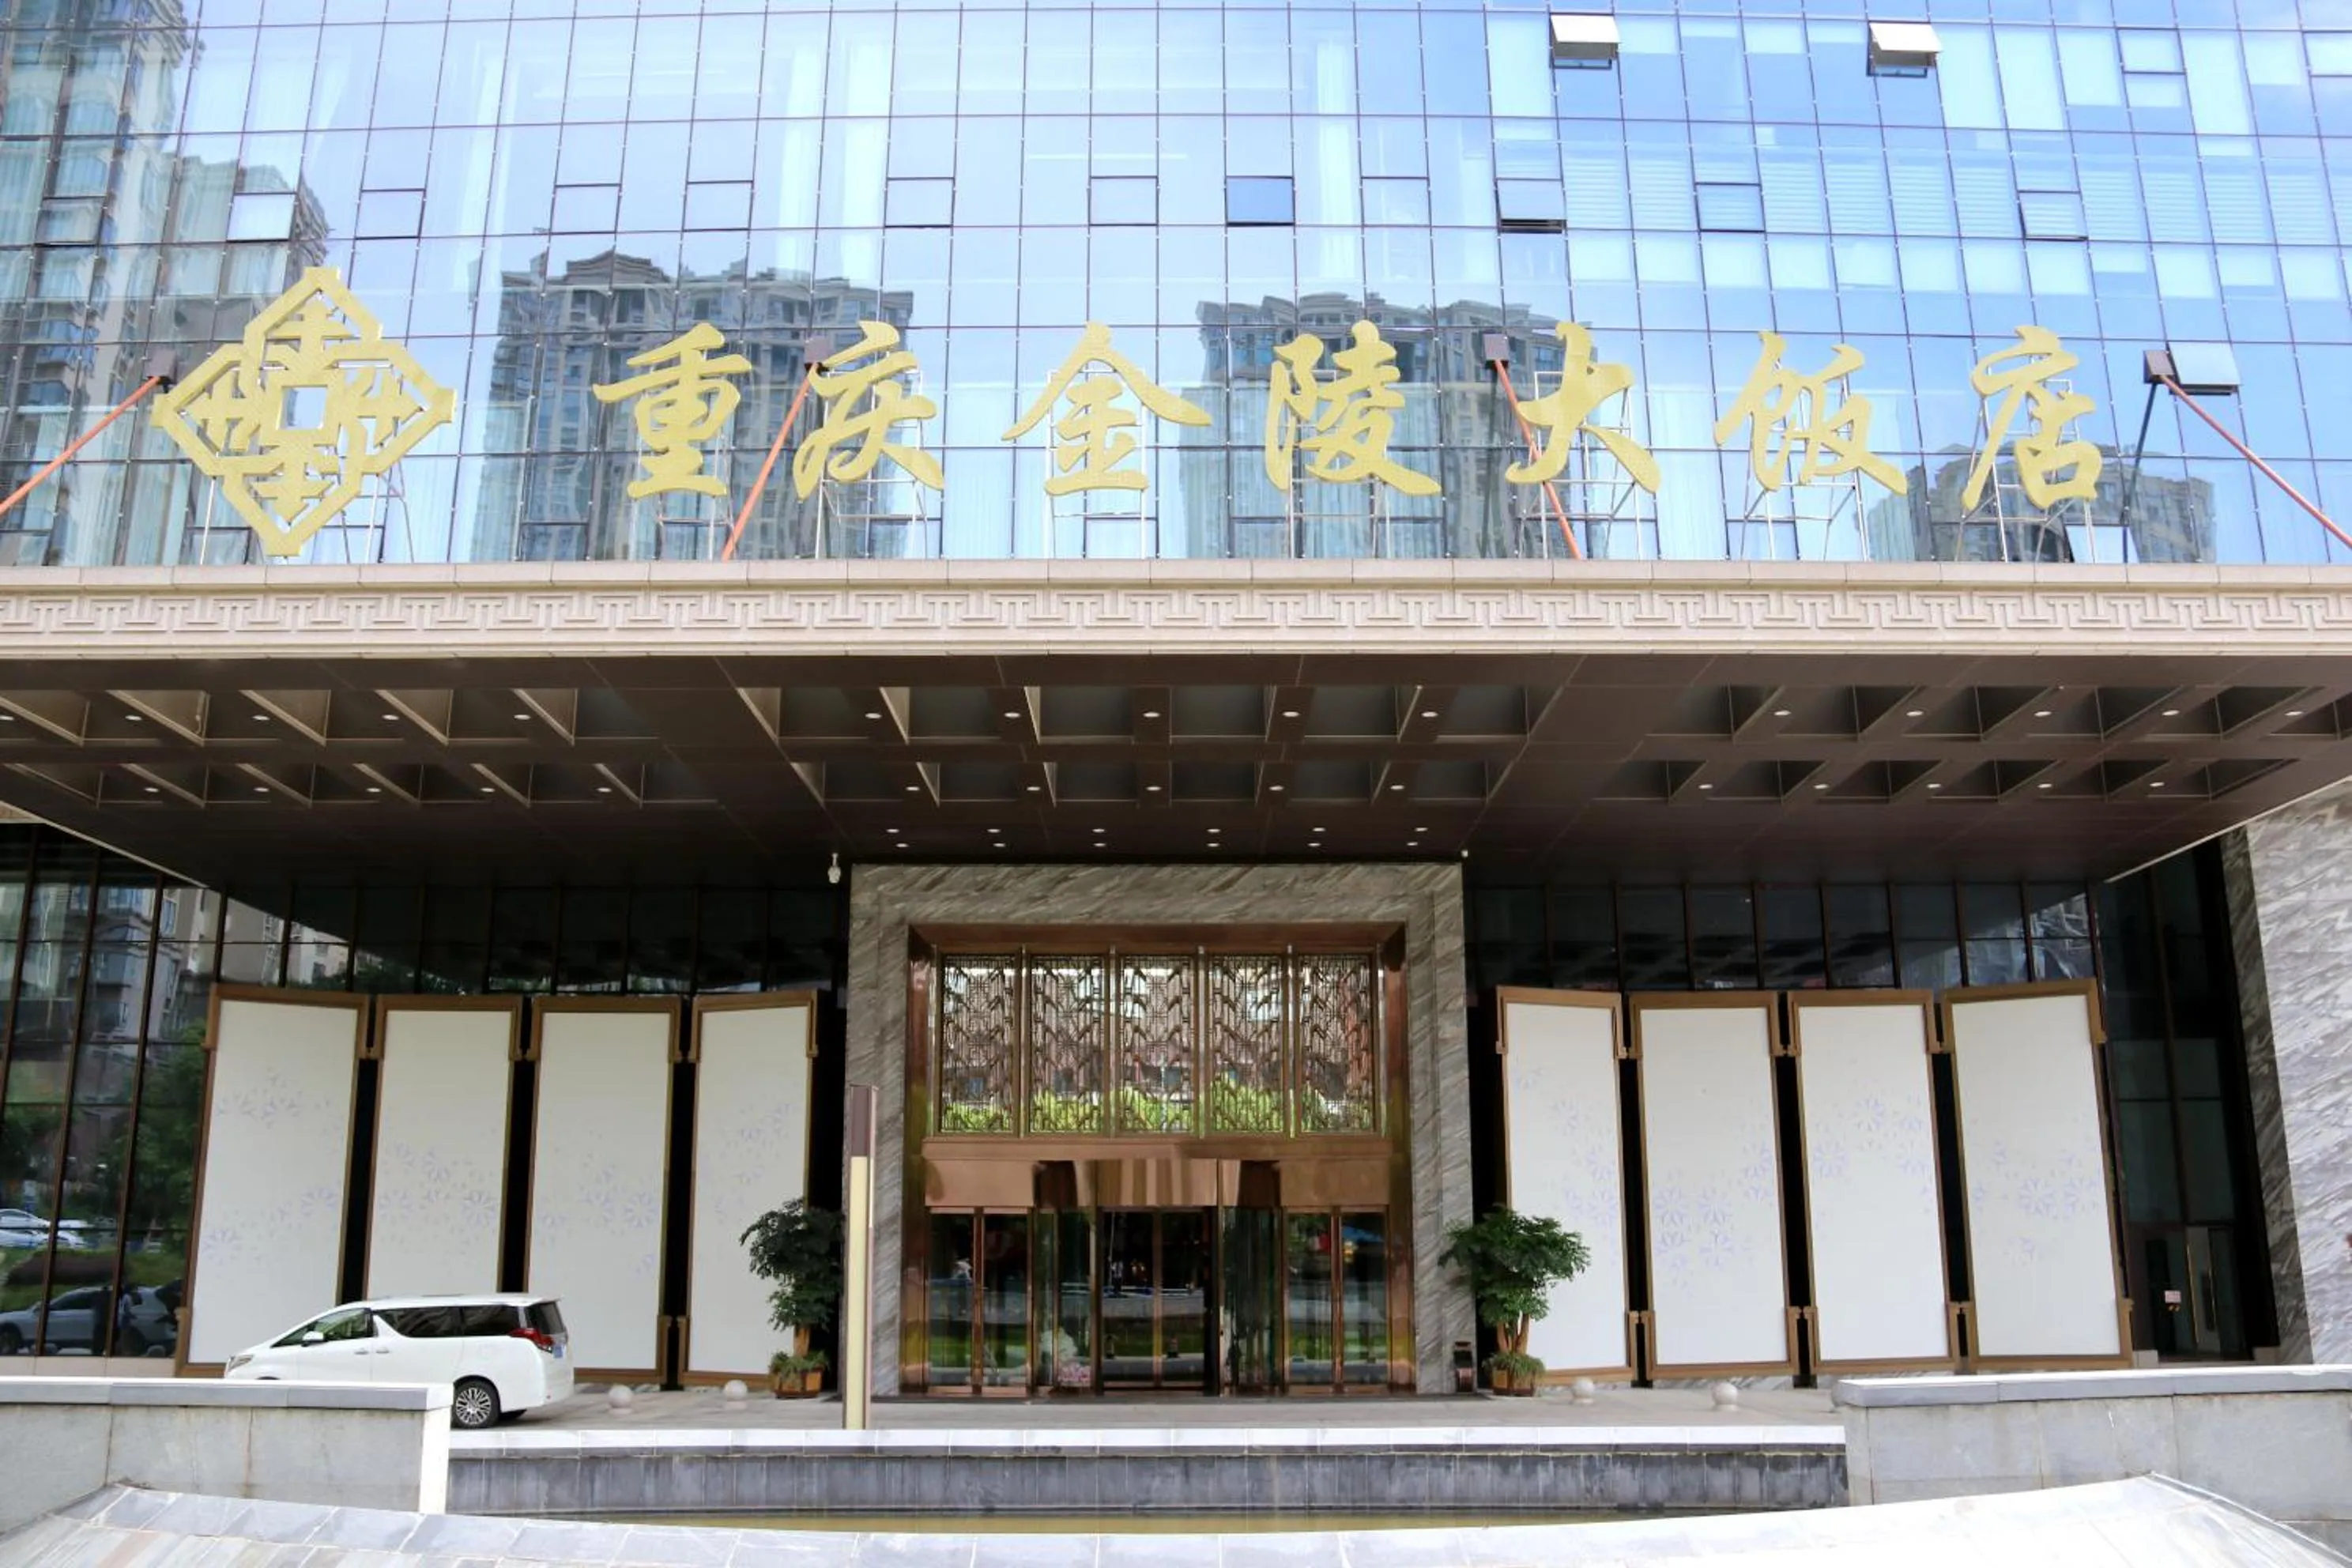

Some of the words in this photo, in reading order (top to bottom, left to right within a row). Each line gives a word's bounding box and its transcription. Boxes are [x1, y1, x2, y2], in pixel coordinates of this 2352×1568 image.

[593, 320, 2102, 511] 重庆金陵大饭店
